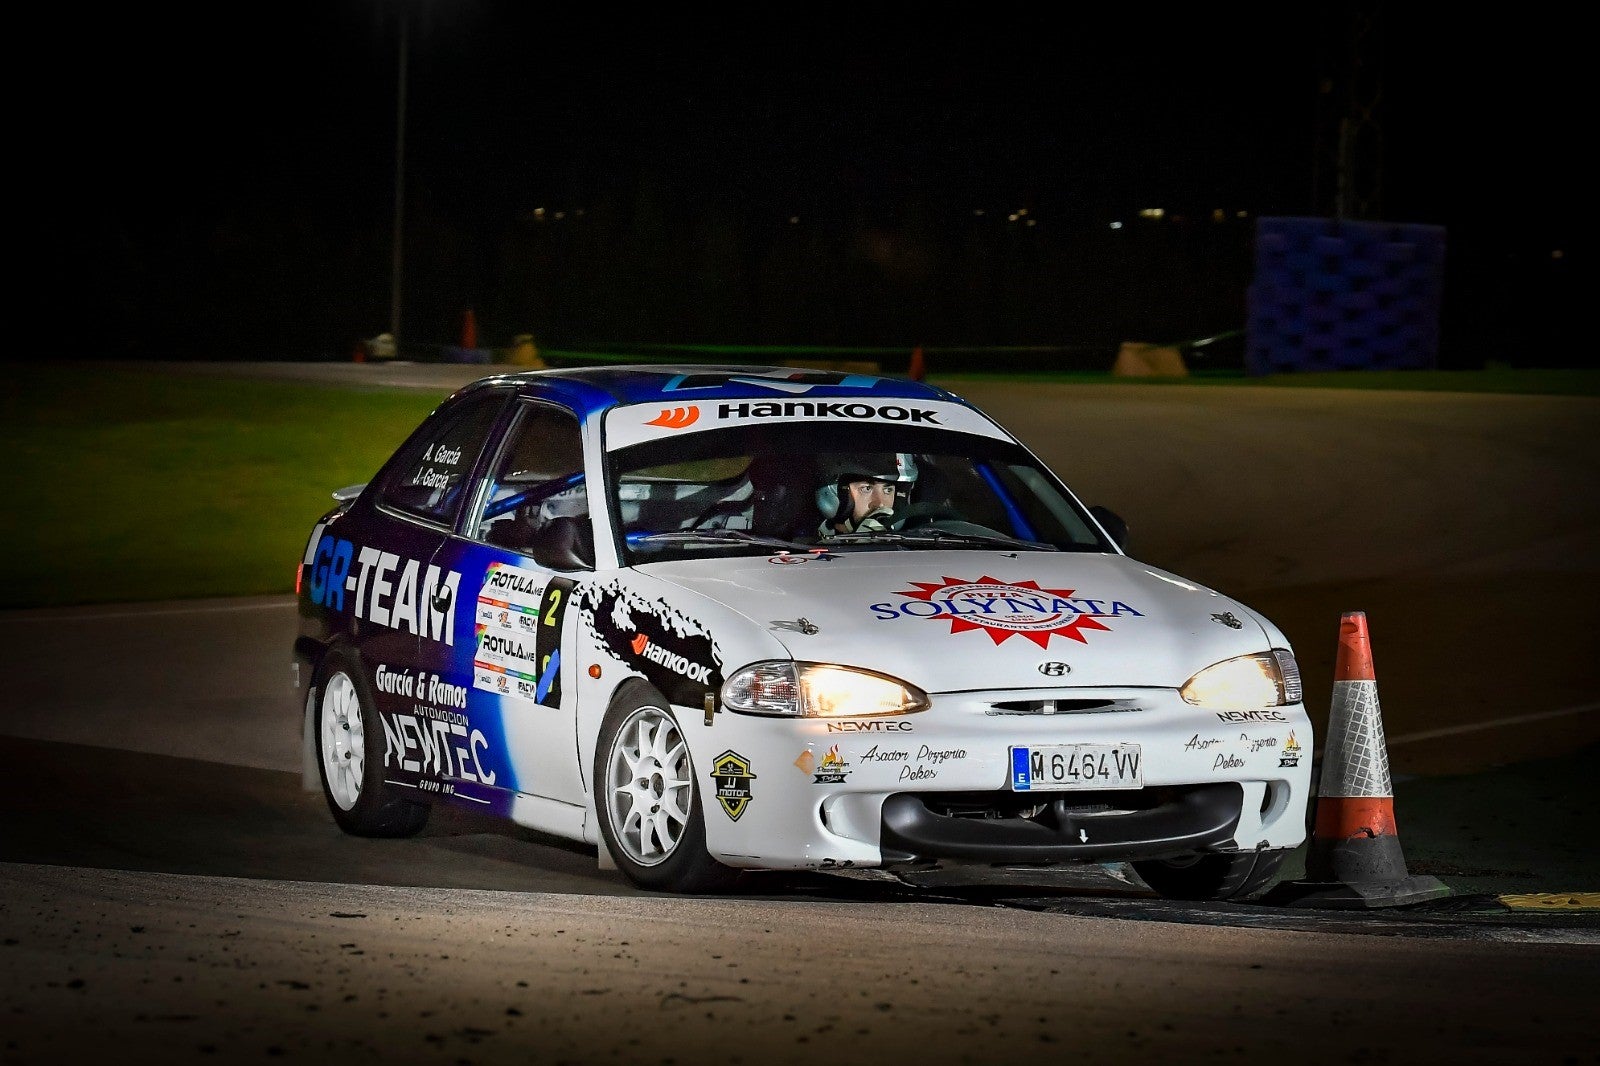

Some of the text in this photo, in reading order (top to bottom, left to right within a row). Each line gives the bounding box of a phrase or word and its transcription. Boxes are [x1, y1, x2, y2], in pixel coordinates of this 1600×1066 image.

[422, 443, 461, 465] A. García
[412, 466, 449, 489] J. García
[310, 535, 462, 647] GR-TEAM
[544, 589, 561, 627] 2
[869, 597, 1146, 620] SOLYNATA
[376, 664, 467, 709] García & Ramos
[414, 704, 469, 727] AUTOMOCION
[1216, 711, 1286, 722] NEWTEC
[827, 721, 913, 733] NEWTEC
[379, 711, 496, 786] NEWTEC
[860, 744, 967, 766] Asador Pizzeria
[899, 764, 938, 783] Pekes
[1031, 752, 1139, 780] M 6464 VV
[1212, 753, 1246, 772] Pekes
[419, 780, 455, 795] GRUPO ING
[724, 777, 736, 789] JJ
[1018, 773, 1026, 783] E
